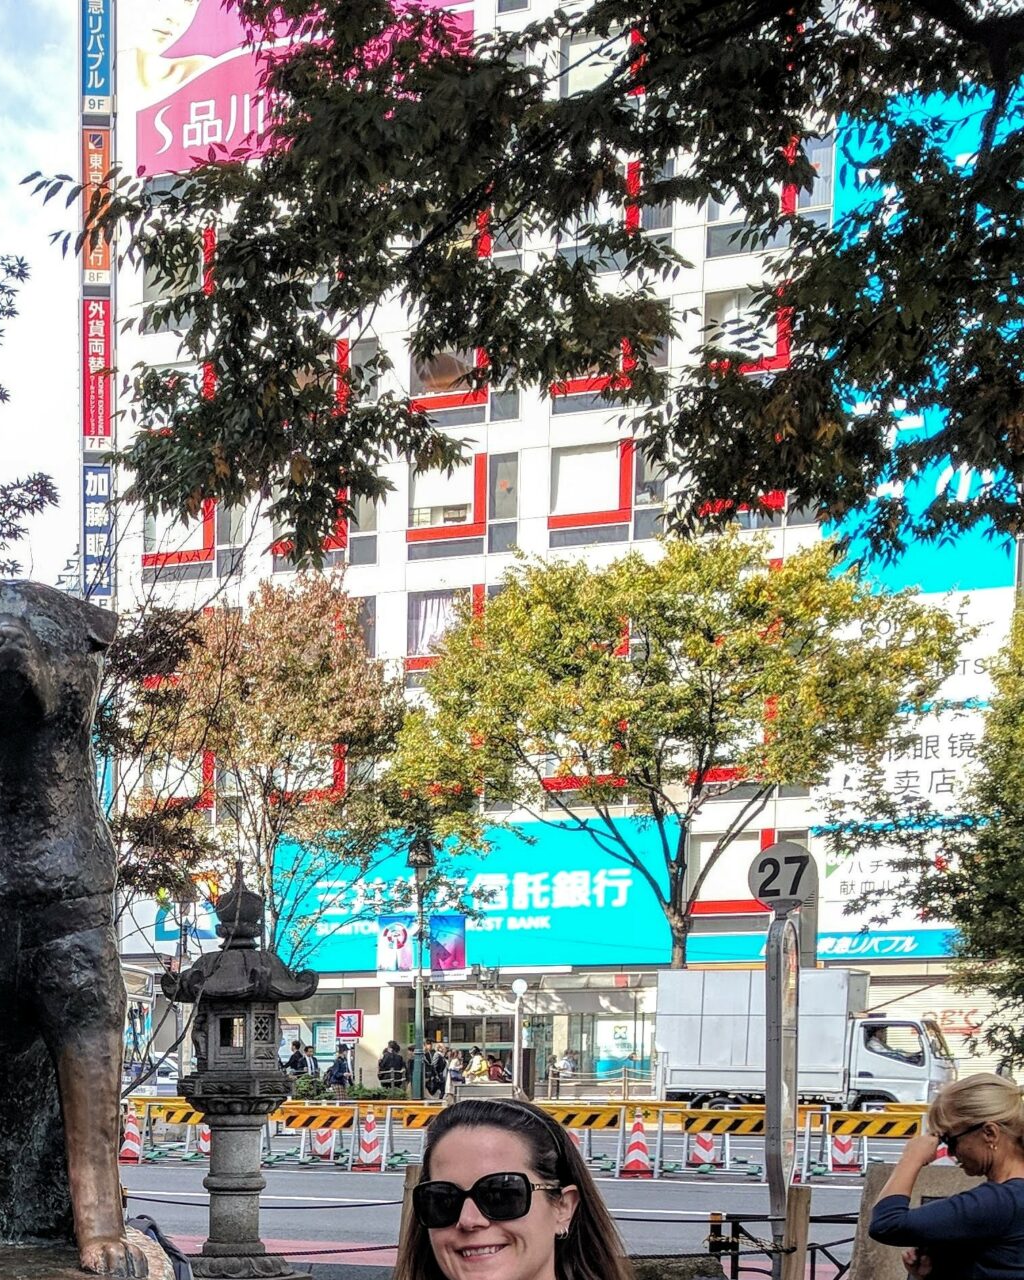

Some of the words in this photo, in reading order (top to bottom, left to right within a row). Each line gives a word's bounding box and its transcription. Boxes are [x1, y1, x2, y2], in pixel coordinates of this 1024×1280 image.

[88, 98, 105, 110] 9F
[88, 271, 104, 282] 8F
[88, 301, 106, 374] 外貨両替
[88, 438, 106, 448] 7F
[757, 854, 810, 898] 27
[506, 916, 552, 931] BANK
